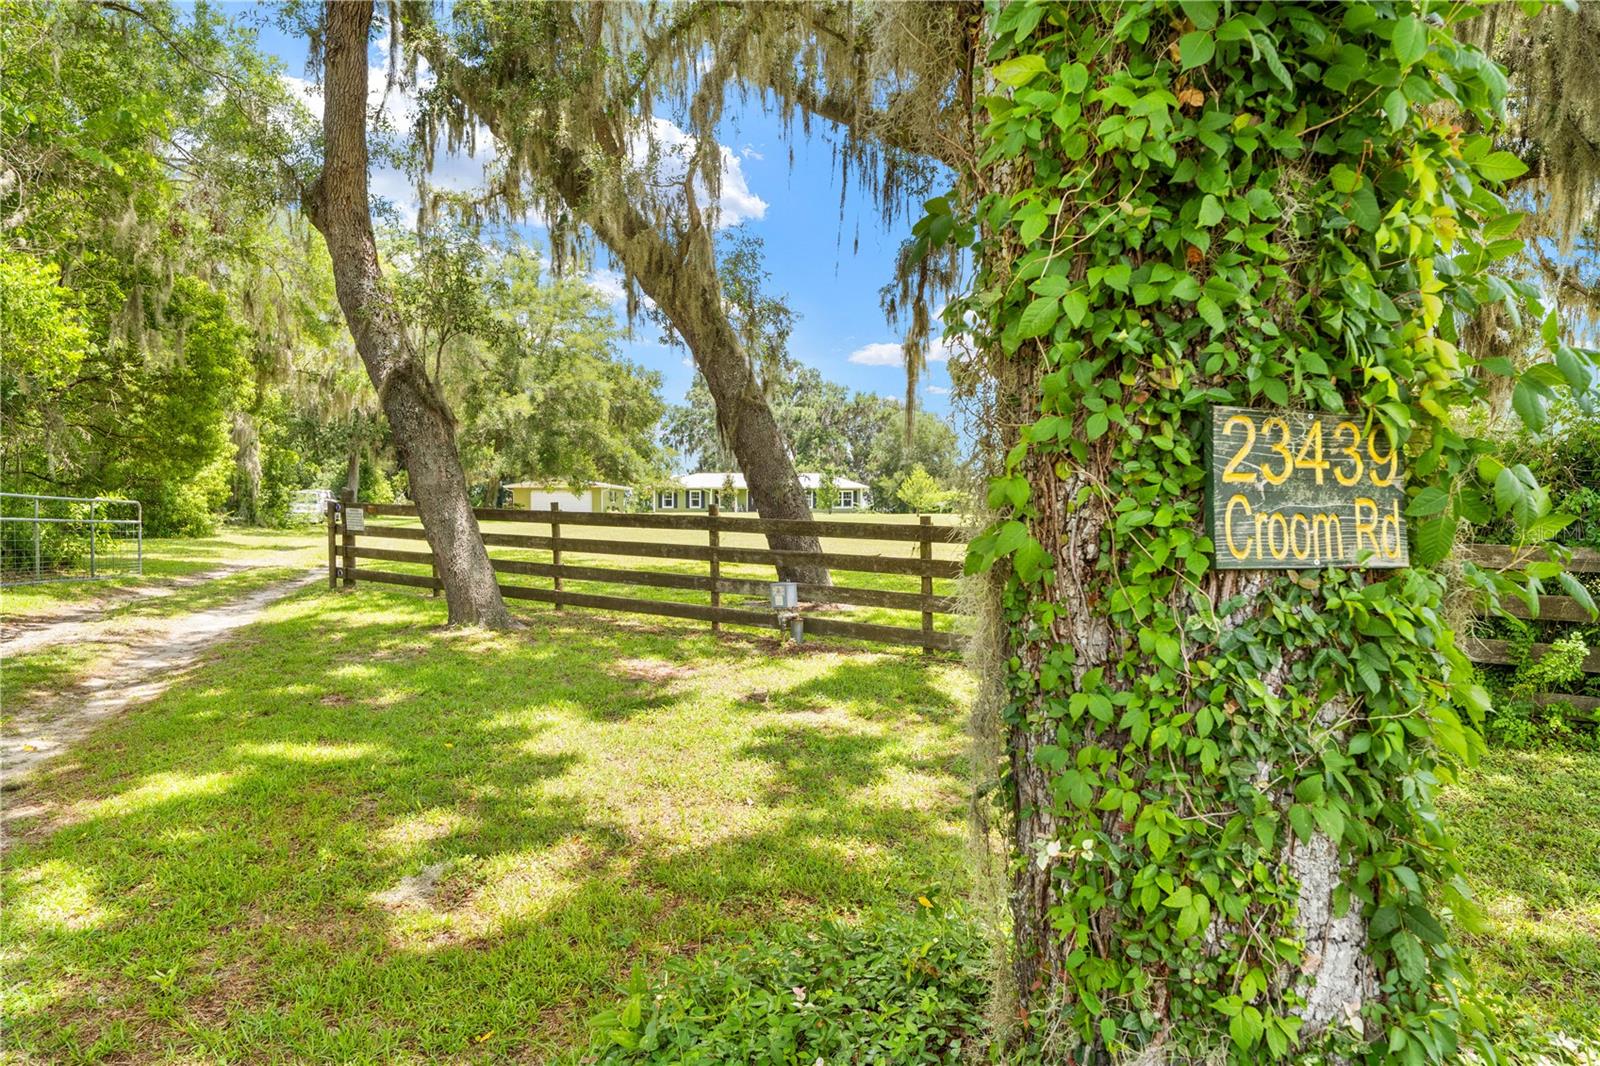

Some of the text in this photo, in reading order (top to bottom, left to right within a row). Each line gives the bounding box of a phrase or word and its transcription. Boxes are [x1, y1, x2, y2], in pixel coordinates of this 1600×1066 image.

[1222, 415, 1398, 487] 23439
[1225, 494, 1401, 560] Croom Rd
